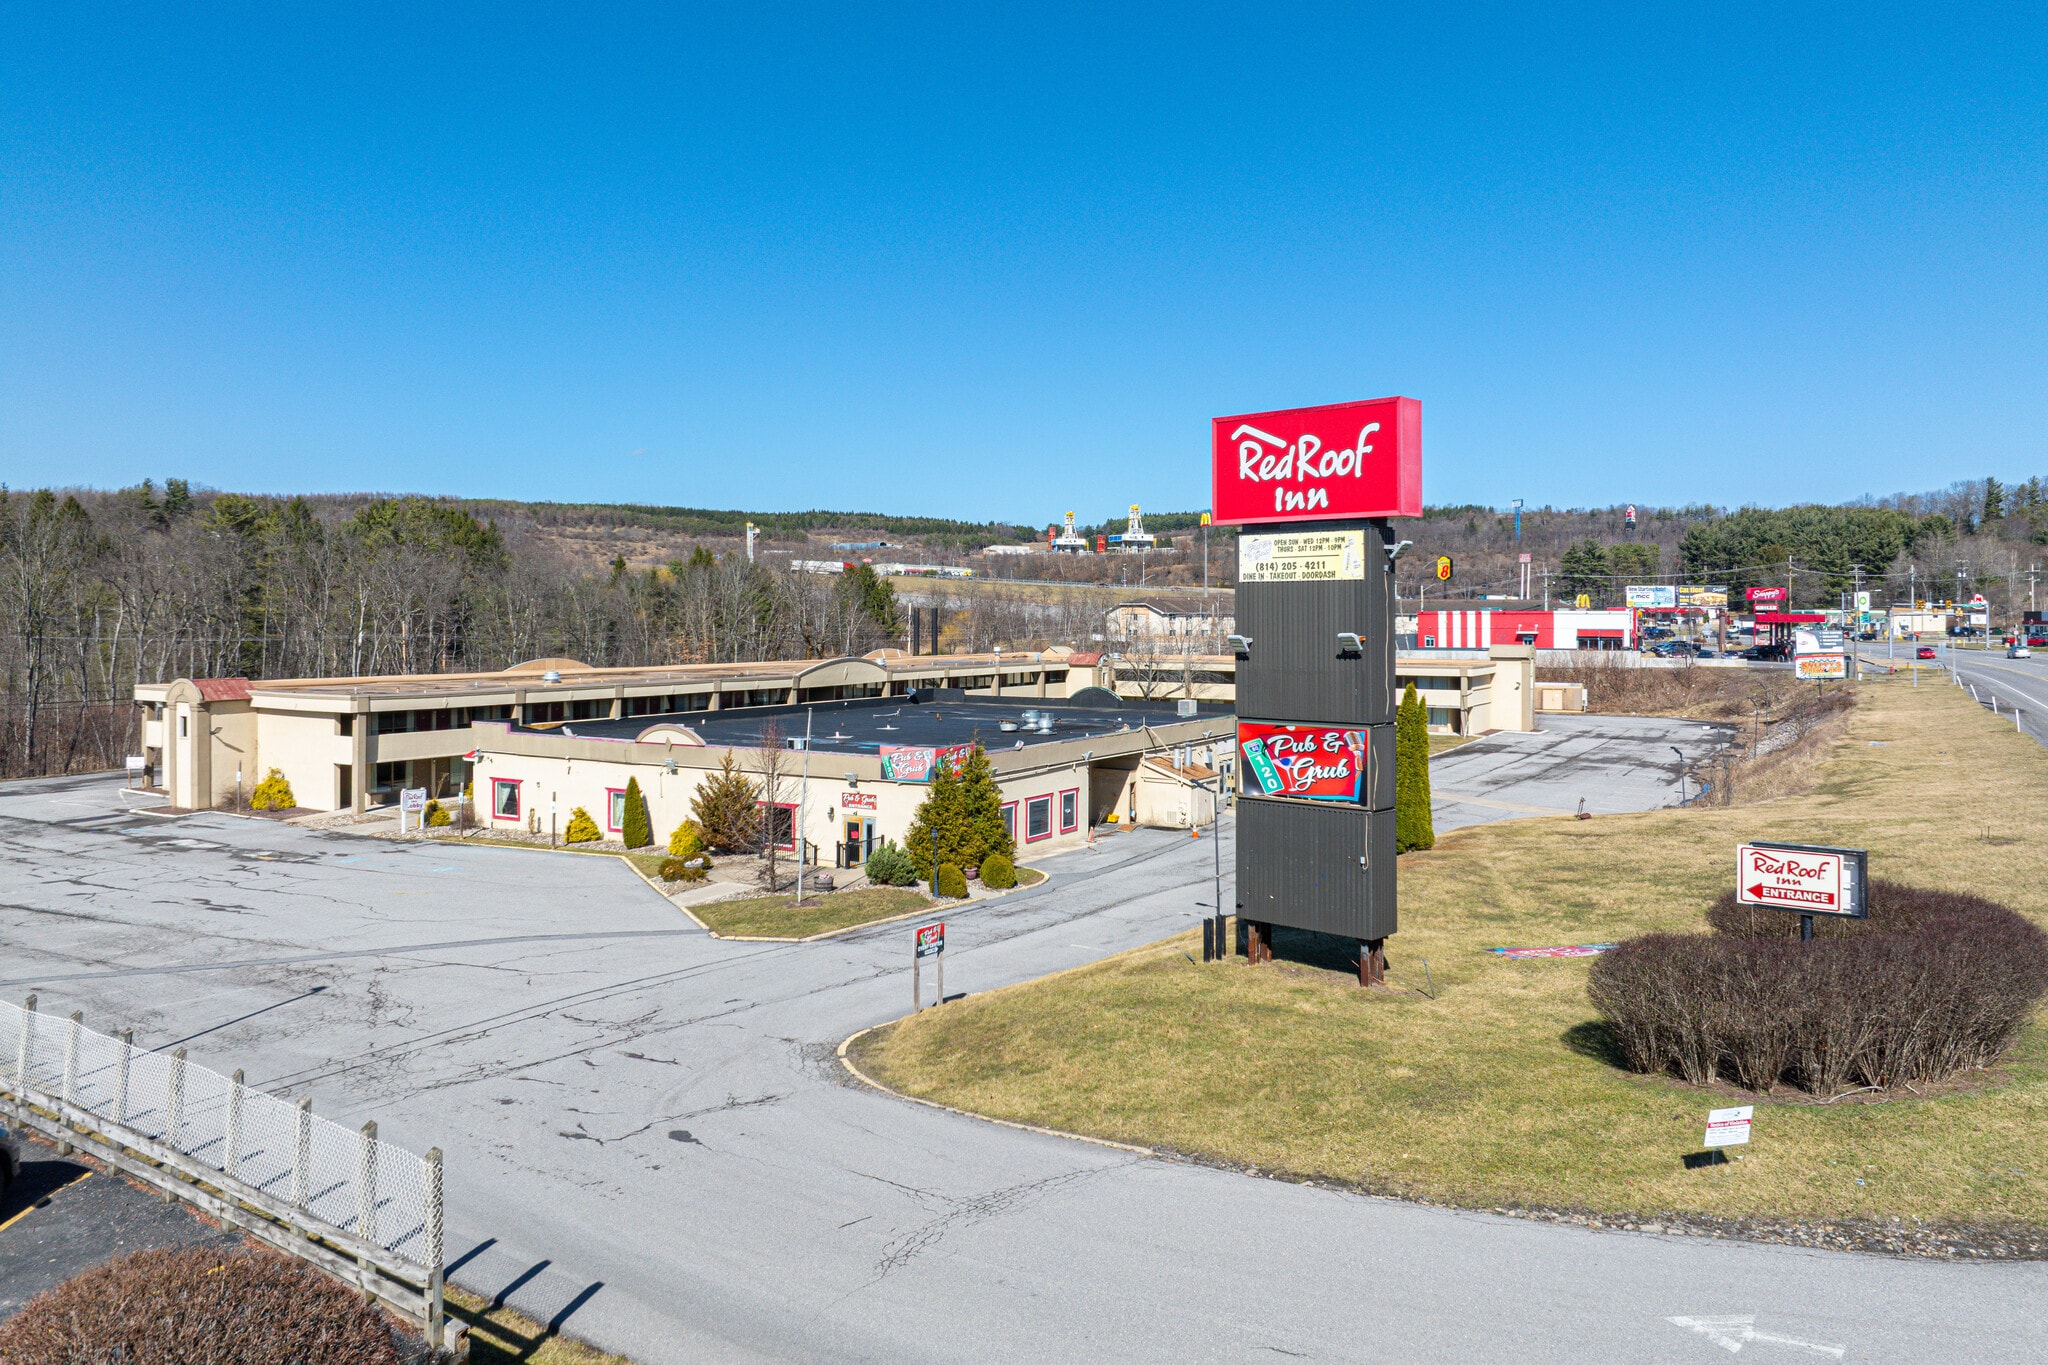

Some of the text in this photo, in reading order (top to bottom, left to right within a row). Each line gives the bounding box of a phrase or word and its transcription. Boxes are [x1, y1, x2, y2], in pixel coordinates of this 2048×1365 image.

[1274, 486, 1329, 512] Inn
[1277, 545, 1294, 553] THURS
[1309, 544, 1323, 552] 12PM
[1327, 543, 1342, 551] 10PM
[1255, 560, 1326, 572] (814) 205 4211
[1441, 565, 1449, 578] 8
[1243, 570, 1336, 580] DINE IN TAKEOUT DOORDASH
[1752, 589, 1780, 600] Snappy's
[1267, 732, 1344, 757] Pub &
[891, 752, 912, 763] Pub
[914, 750, 924, 760] &
[900, 762, 925, 778] Grub
[1290, 757, 1351, 791] Grub
[1776, 876, 1802, 886] Inn
[1762, 887, 1829, 903] ENTRANCE
